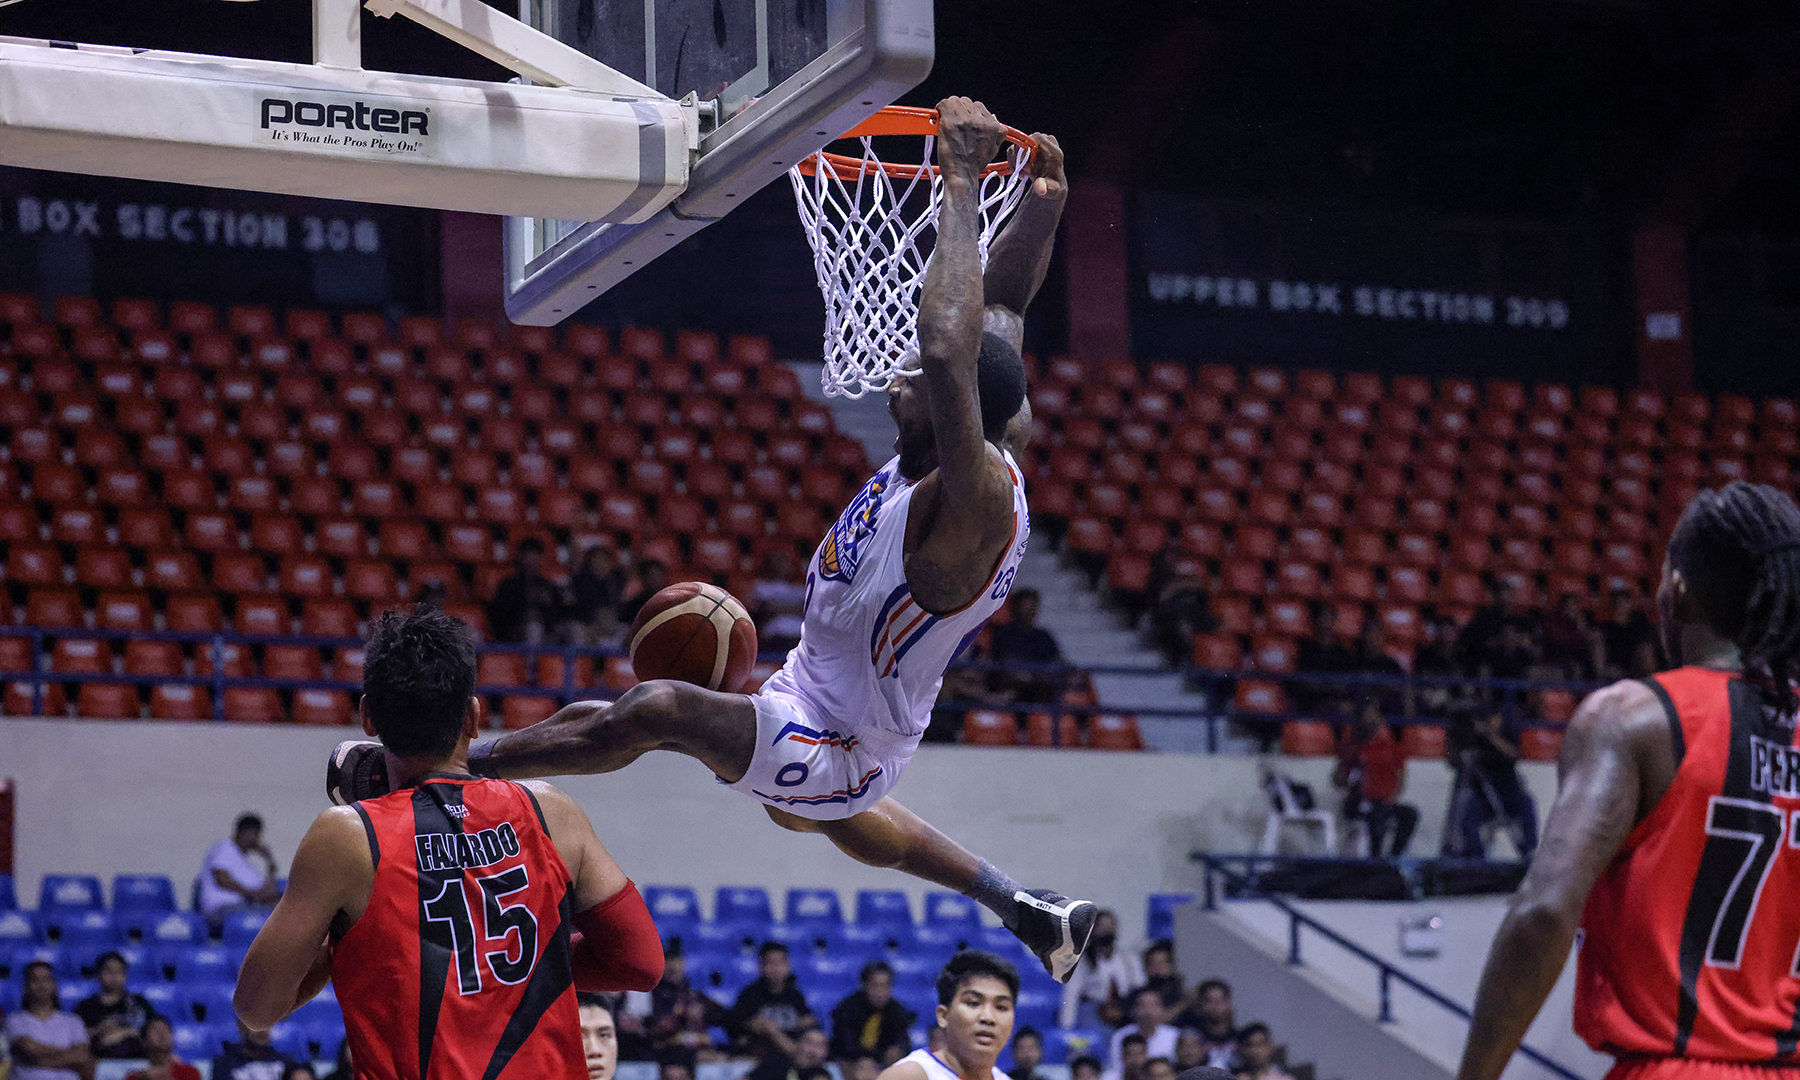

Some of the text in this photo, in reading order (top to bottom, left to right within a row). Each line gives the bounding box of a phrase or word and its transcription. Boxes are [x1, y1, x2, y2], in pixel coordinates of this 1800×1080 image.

[272, 129, 289, 141] It's
[293, 131, 320, 144] What
[323, 135, 341, 145] the
[343, 136, 368, 148] Pros
[370, 138, 395, 152] Play
[17, 197, 100, 235] BOX
[116, 203, 288, 248] SECTION
[1148, 273, 1258, 307] UPPER
[1269, 280, 1341, 314] BOX
[1353, 286, 1495, 324] SECTION
[415, 822, 520, 871] FAJARDO
[1705, 796, 1800, 977] 7
[423, 864, 538, 996] 15
